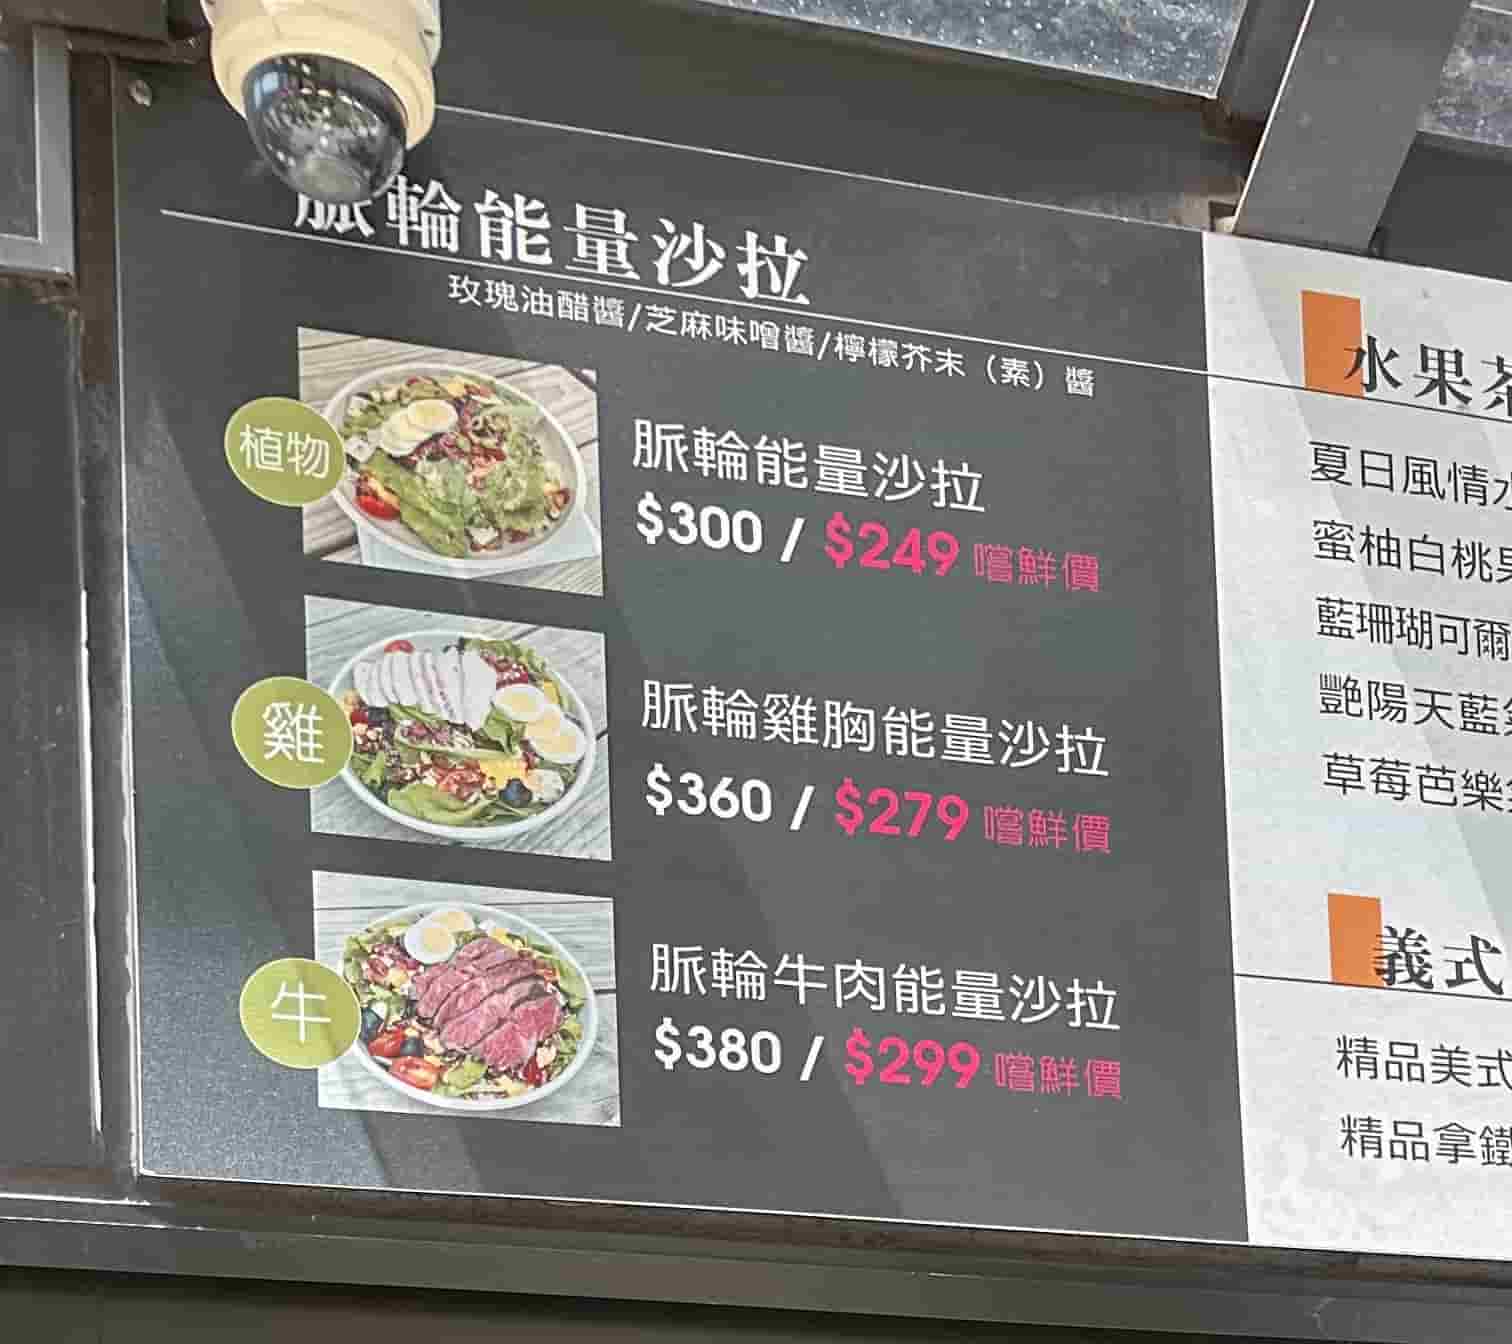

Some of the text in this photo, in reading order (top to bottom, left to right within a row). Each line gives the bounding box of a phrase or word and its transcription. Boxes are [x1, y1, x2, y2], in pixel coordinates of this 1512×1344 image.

[240, 422, 330, 479] 植物
[633, 419, 985, 513] 脈輪能量沙拉
[636, 491, 763, 554] $300
[825, 512, 960, 577] $249
[263, 701, 324, 765] 雞
[642, 680, 1109, 777] 脈輪雞胸能量沙拉
[645, 763, 772, 822] $360
[834, 776, 969, 841] $279
[270, 981, 331, 1043] 牛
[649, 943, 1121, 1030] 脈輪牛肉能量沙拉
[654, 1017, 782, 1075] $380
[844, 1027, 981, 1089] $299
